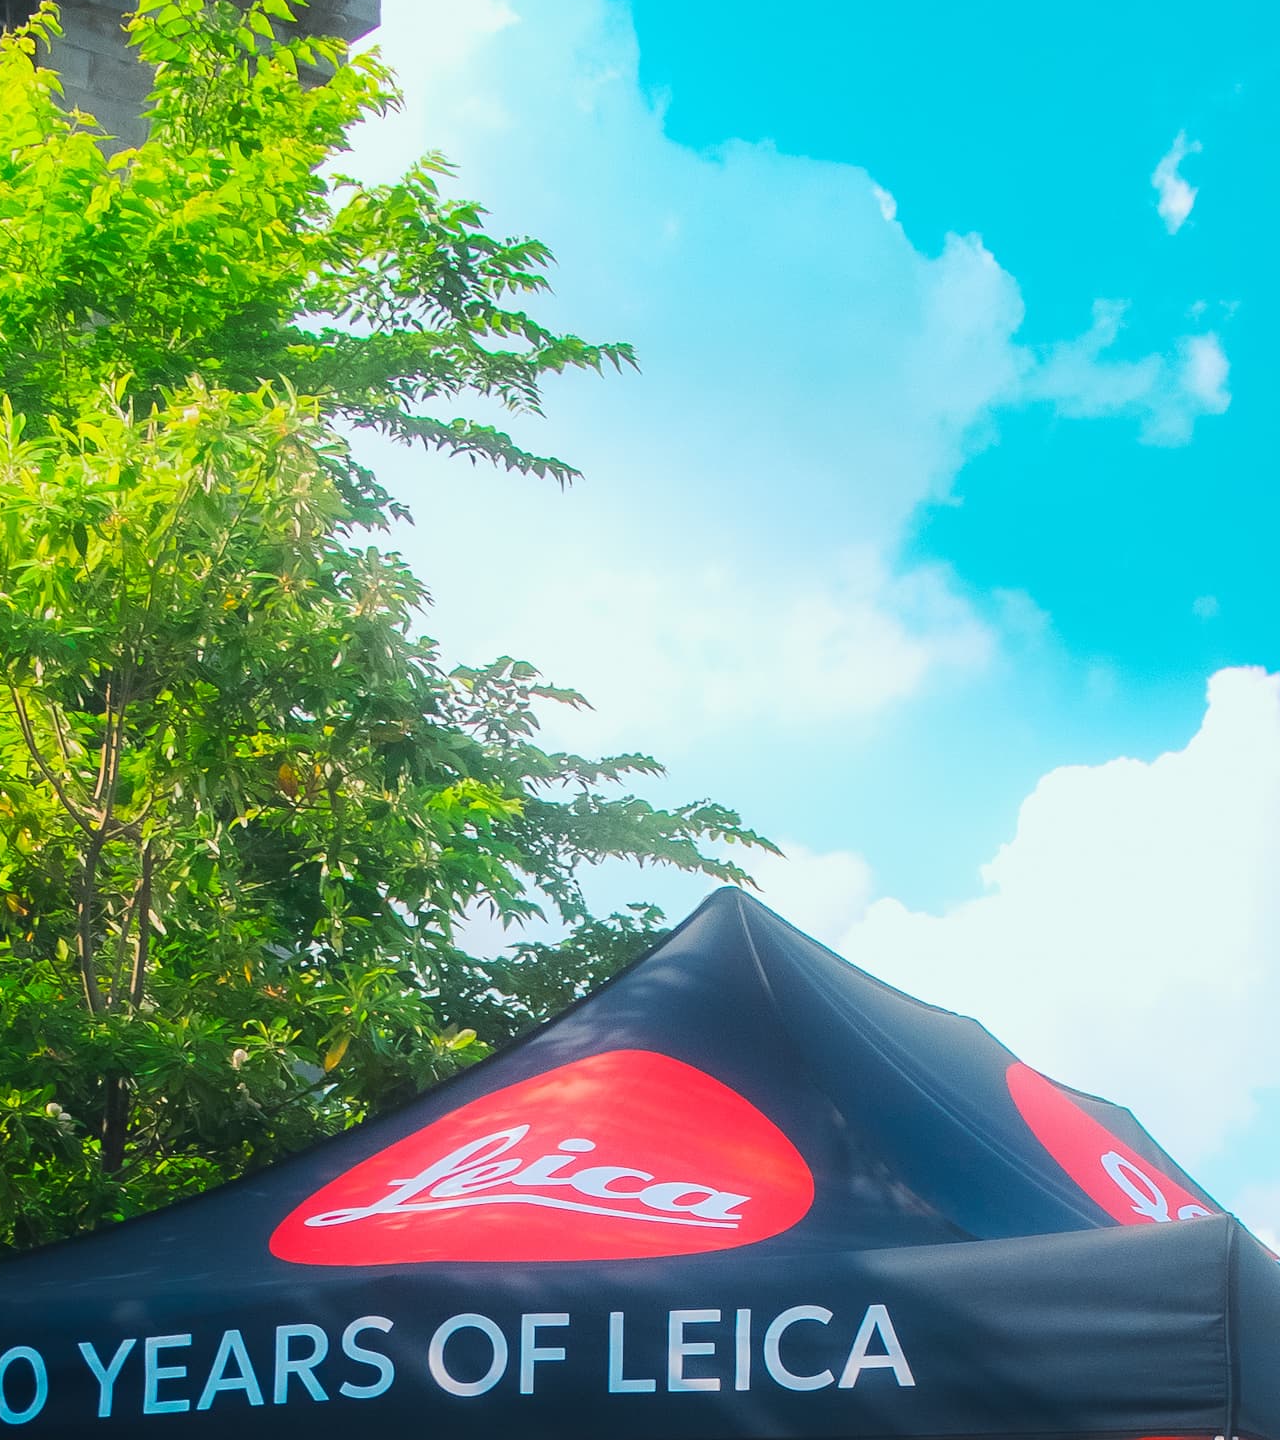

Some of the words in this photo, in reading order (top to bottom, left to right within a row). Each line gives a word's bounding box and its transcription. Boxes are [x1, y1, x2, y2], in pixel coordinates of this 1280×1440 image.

[303, 1123, 752, 1230] Leica
[78, 1315, 396, 1418] YEARS
[428, 1312, 570, 1397] OF
[608, 1304, 917, 1393] LEICA
